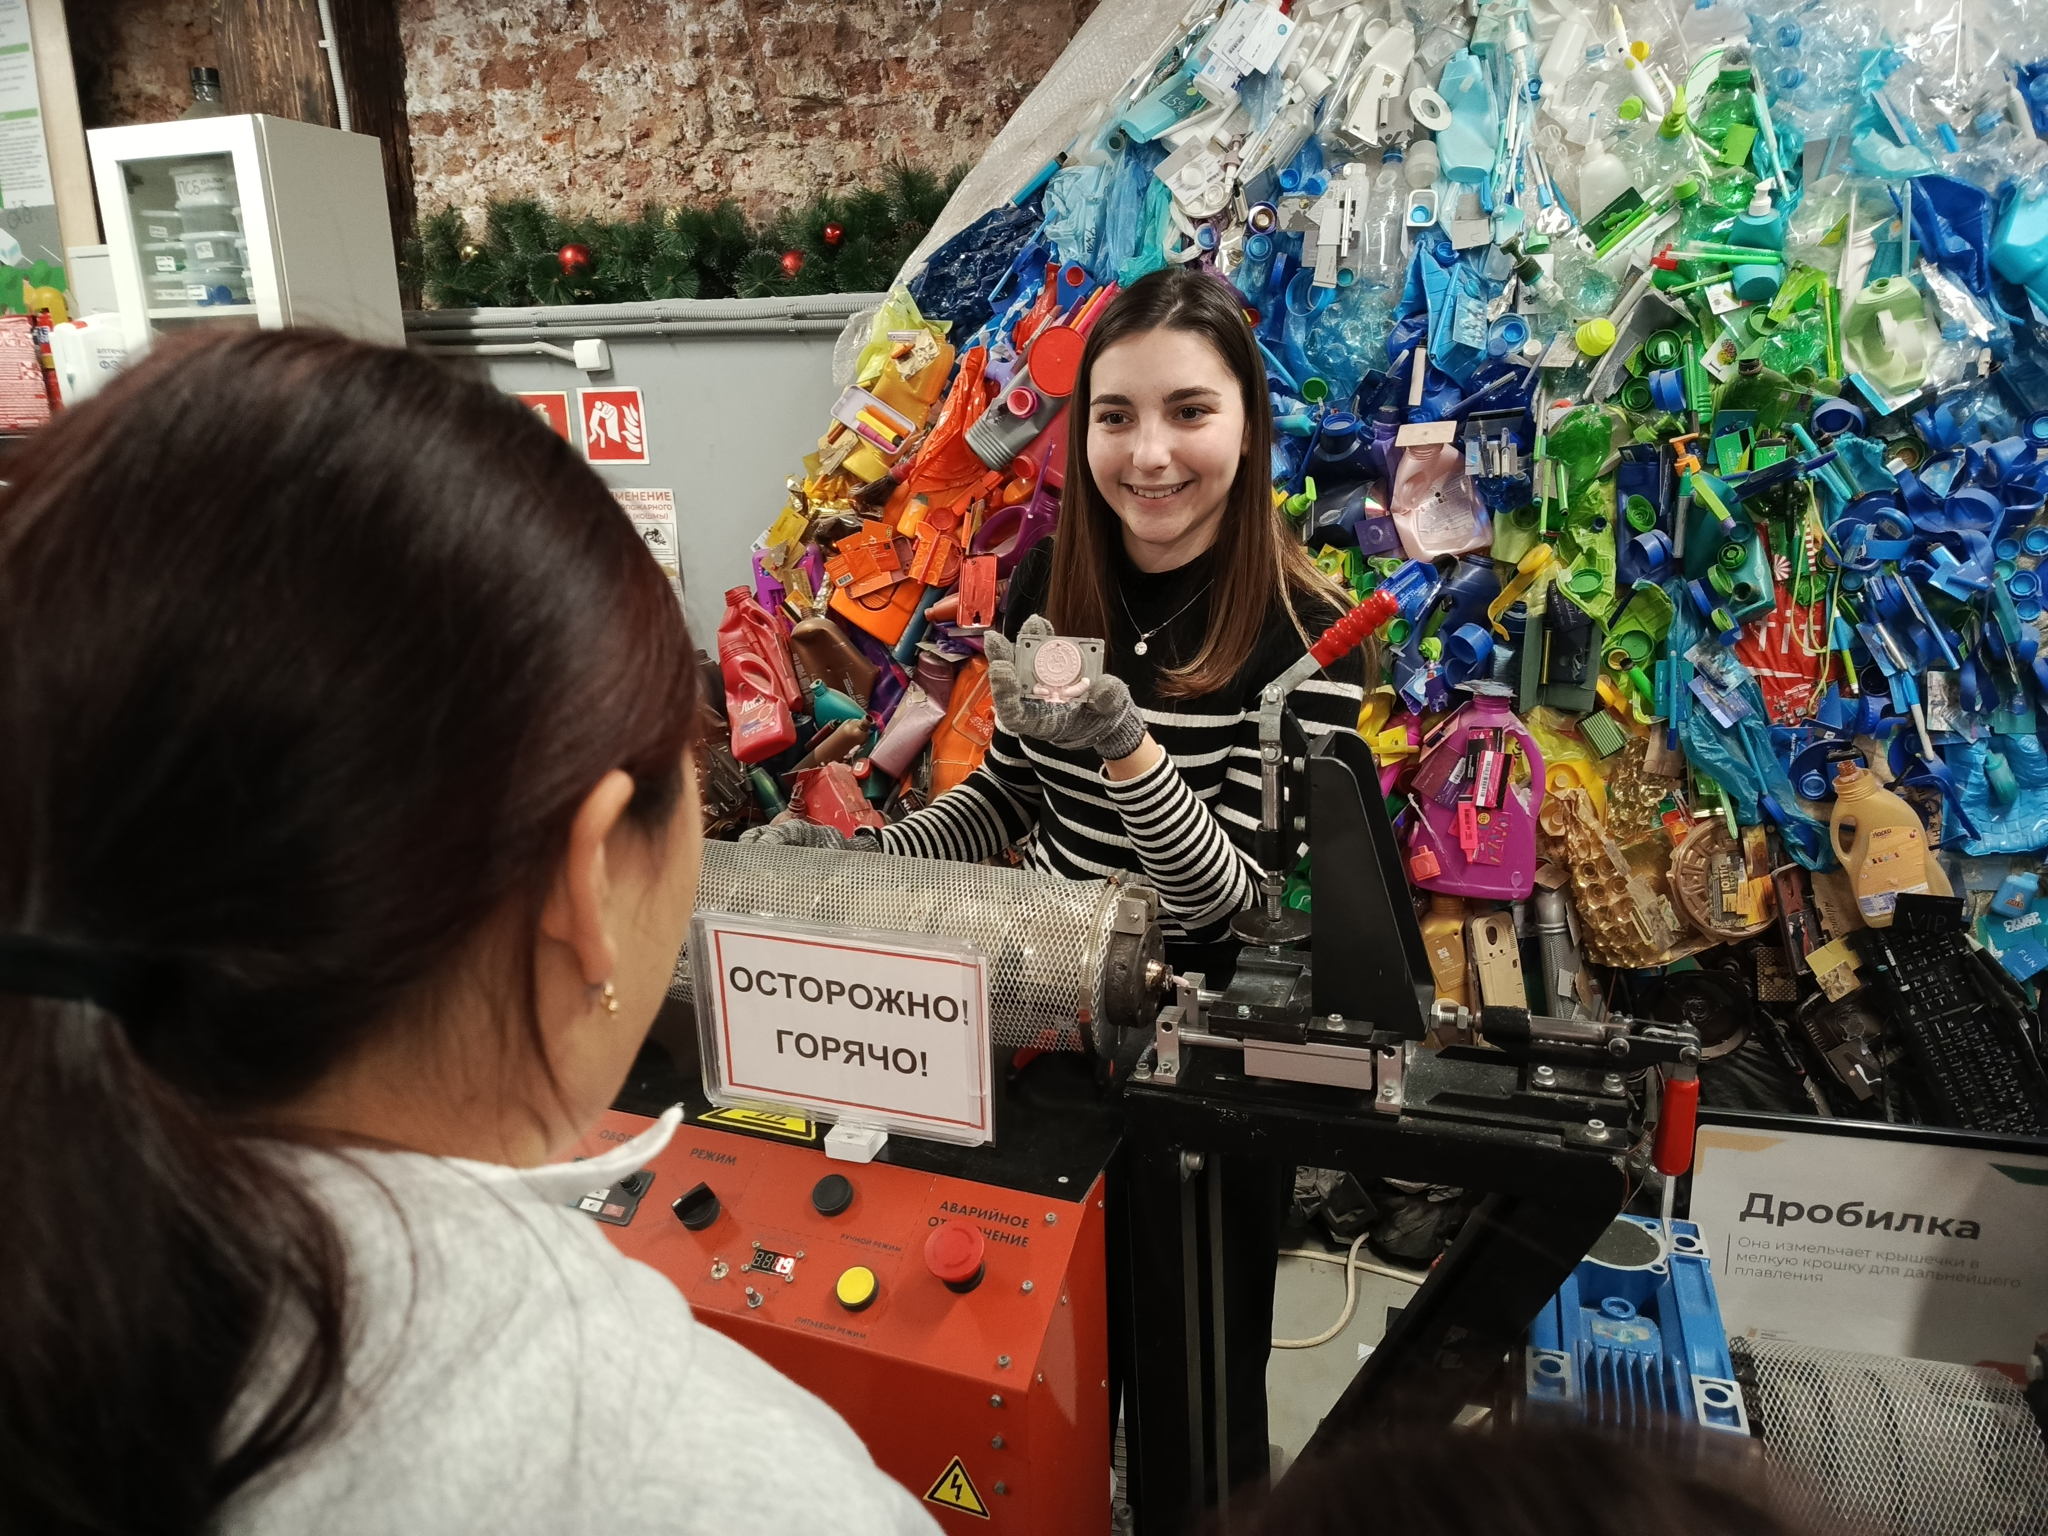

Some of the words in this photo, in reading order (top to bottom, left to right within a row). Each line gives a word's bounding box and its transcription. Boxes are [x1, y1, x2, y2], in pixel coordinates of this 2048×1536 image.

[1163, 94, 1189, 113] 15%
[613, 491, 672, 502] МЕНЕНИЕ
[2018, 949, 2038, 968] FUN
[729, 966, 970, 1026] ОСТОРОЖНО!
[776, 1029, 928, 1077] ГОРЯЧО!
[690, 1147, 737, 1166] РЕЖИМ
[939, 1200, 1030, 1229] АВАРИЙНОЕ
[1739, 1192, 1981, 1240] Дробилка
[1738, 1236, 1771, 1250] Она
[1775, 1241, 1872, 1259] измельчает
[1875, 1251, 1966, 1270] крышечки
[1970, 1260, 1979, 1270] в
[1735, 1266, 1824, 1284] плавления
[1736, 1252, 1798, 1270] мелкую
[1803, 1258, 1866, 1276] крошку
[1868, 1264, 1900, 1277] для
[1903, 1267, 2021, 1289] дальнейшего
